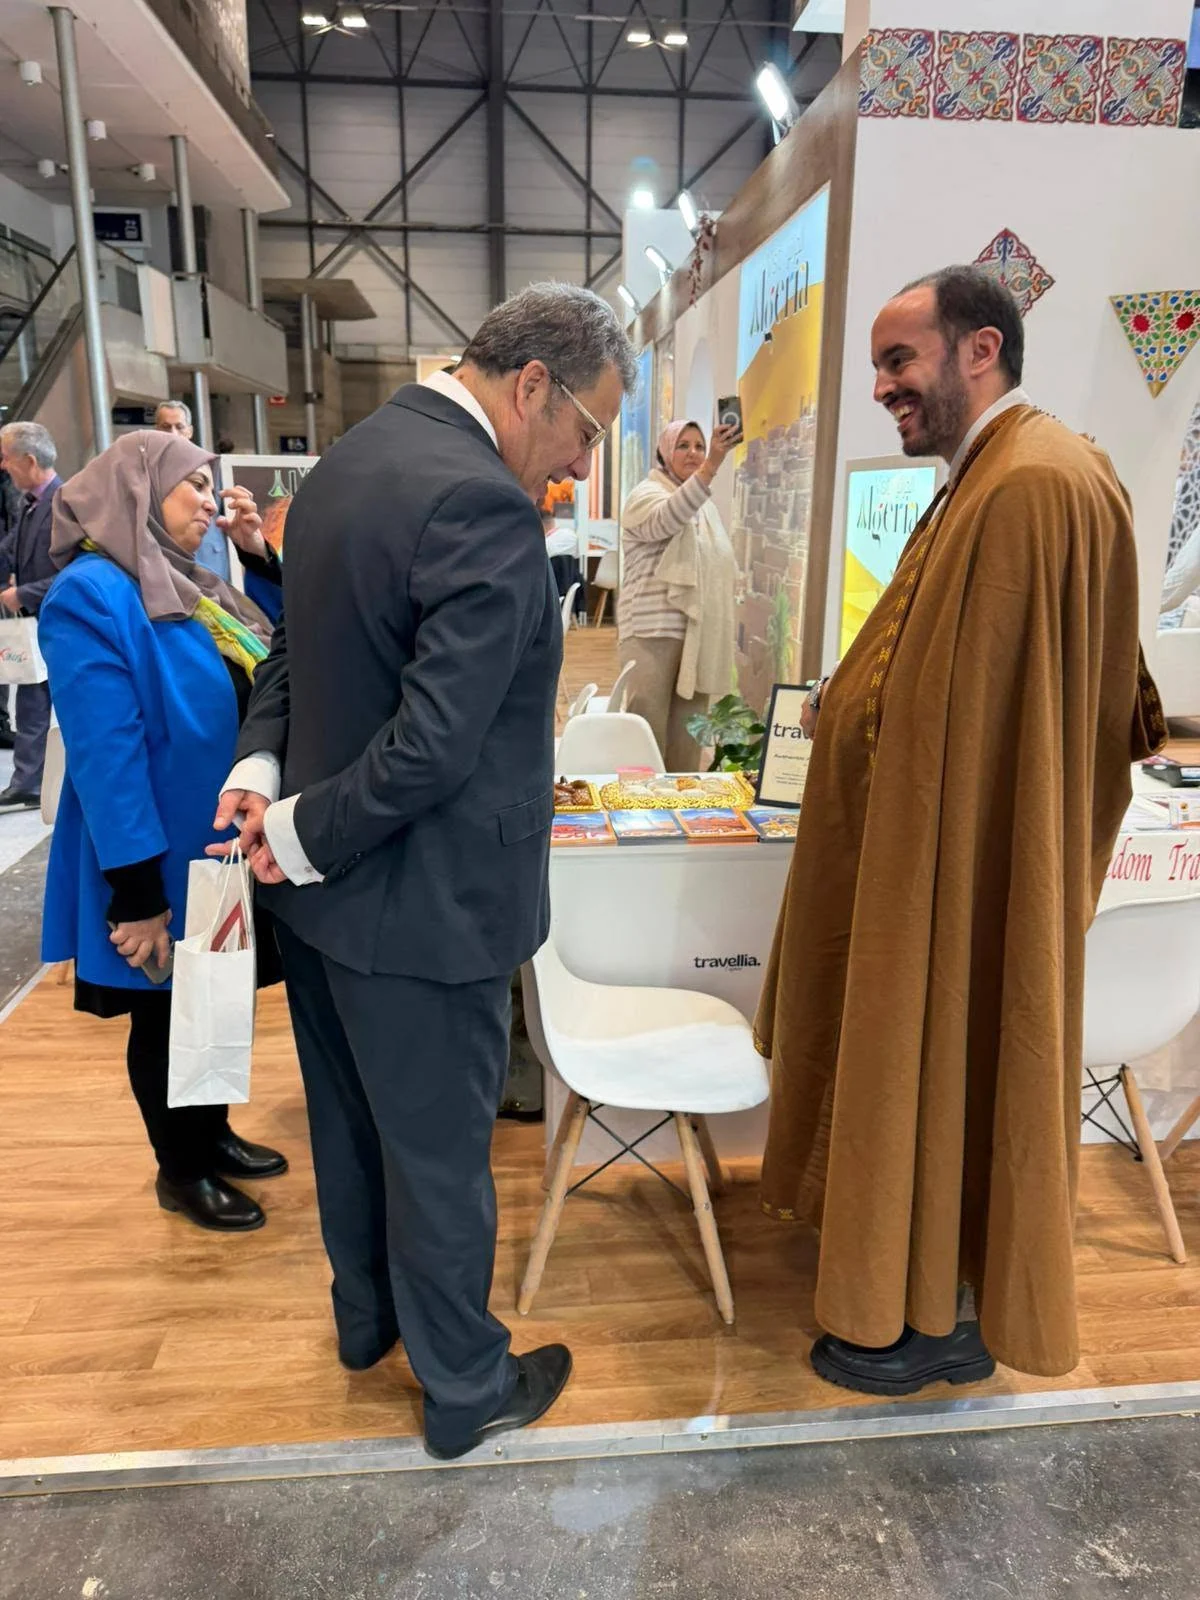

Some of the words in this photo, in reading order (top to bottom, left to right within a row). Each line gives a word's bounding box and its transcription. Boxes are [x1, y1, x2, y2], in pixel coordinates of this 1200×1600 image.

[749, 261, 809, 342] Algeria
[856, 485, 919, 546] Algeria
[1106, 836, 1152, 881] dom
[694, 954, 761, 968] travellia.
